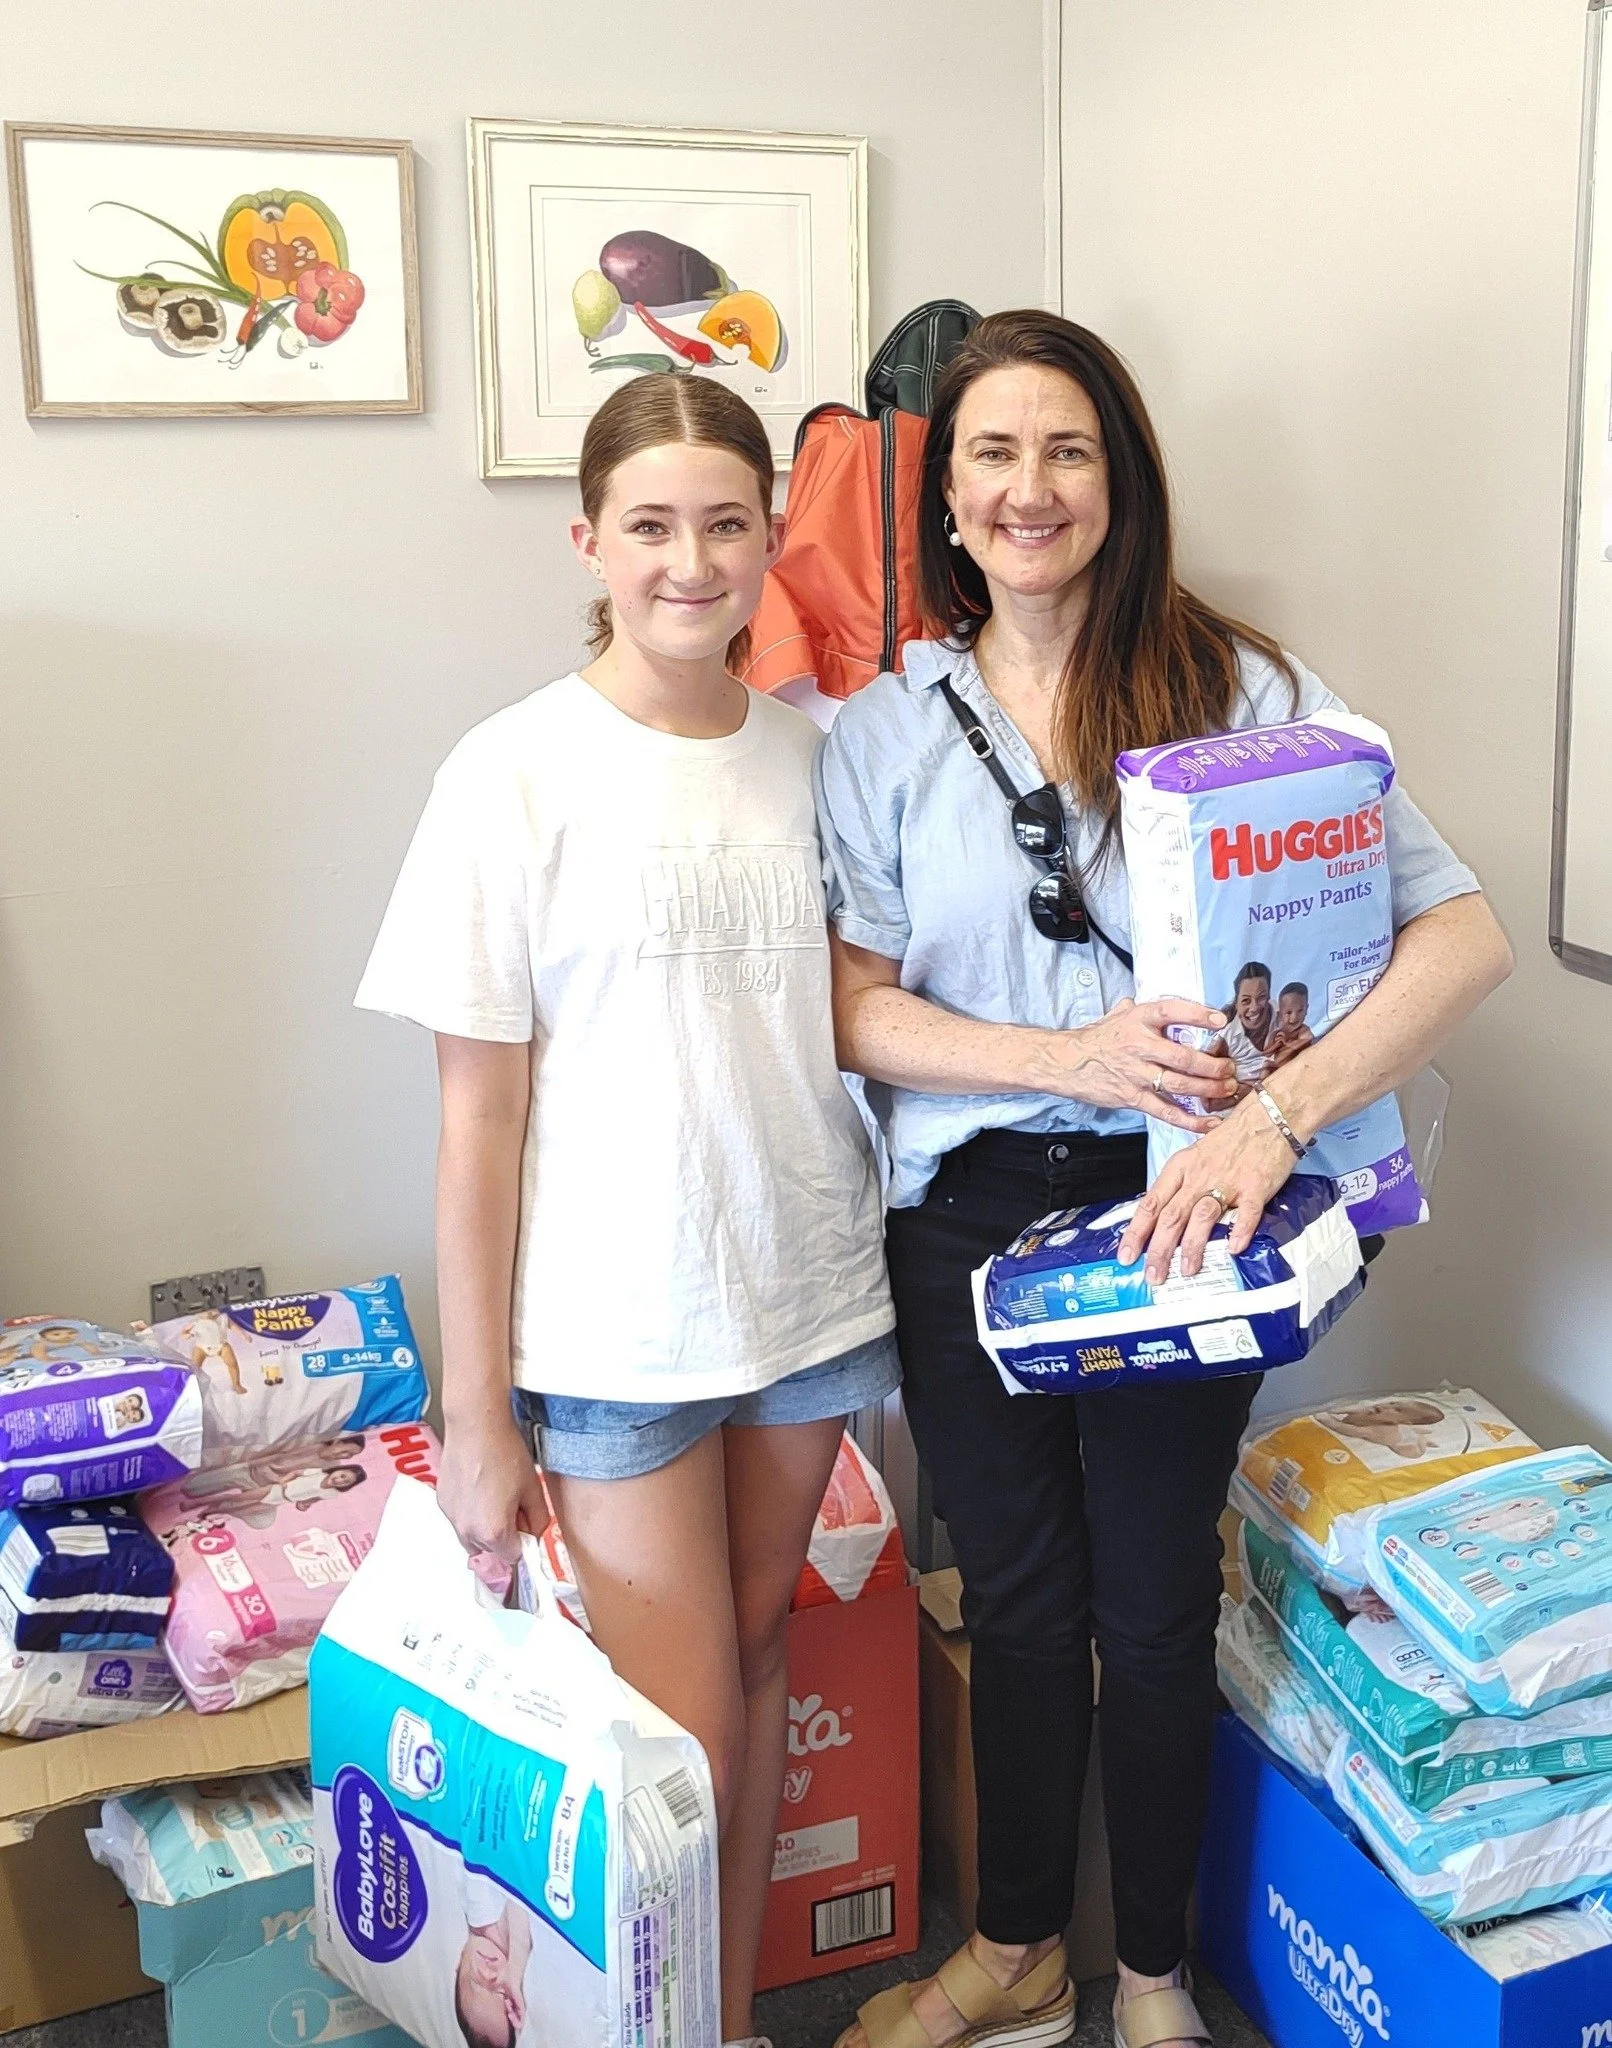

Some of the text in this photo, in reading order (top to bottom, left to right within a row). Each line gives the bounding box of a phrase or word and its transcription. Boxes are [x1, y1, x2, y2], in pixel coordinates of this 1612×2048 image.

[1210, 804, 1382, 880] HUGGIES
[1327, 850, 1387, 878] Ultra Dry
[1249, 880, 1372, 925] Nappy Pants
[1329, 934, 1390, 961] Tailor-Made
[1344, 953, 1380, 970] For Boys
[735, 957, 781, 993] 1984
[1389, 1154, 1404, 1174] 36
[1340, 1173, 1370, 1195] 6-12
[253, 1305, 307, 1320] Nappy
[254, 1314, 315, 1333] Pants
[307, 1351, 409, 1370] 28 9-14kg 4
[1076, 1345, 1121, 1361] PANTS
[56, 1365, 74, 1376] 4
[1080, 1357, 1124, 1373] NIGHT
[198, 1537, 225, 1551] 6
[561, 1796, 576, 1820] 84
[357, 1792, 378, 1940] BabyLove
[379, 1832, 396, 1930] Cosifit
[398, 1854, 410, 1930] Nappies
[553, 1891, 570, 1910] 1
[1268, 1884, 1390, 2041] mamia
[1287, 1941, 1365, 2048] UltraDry
